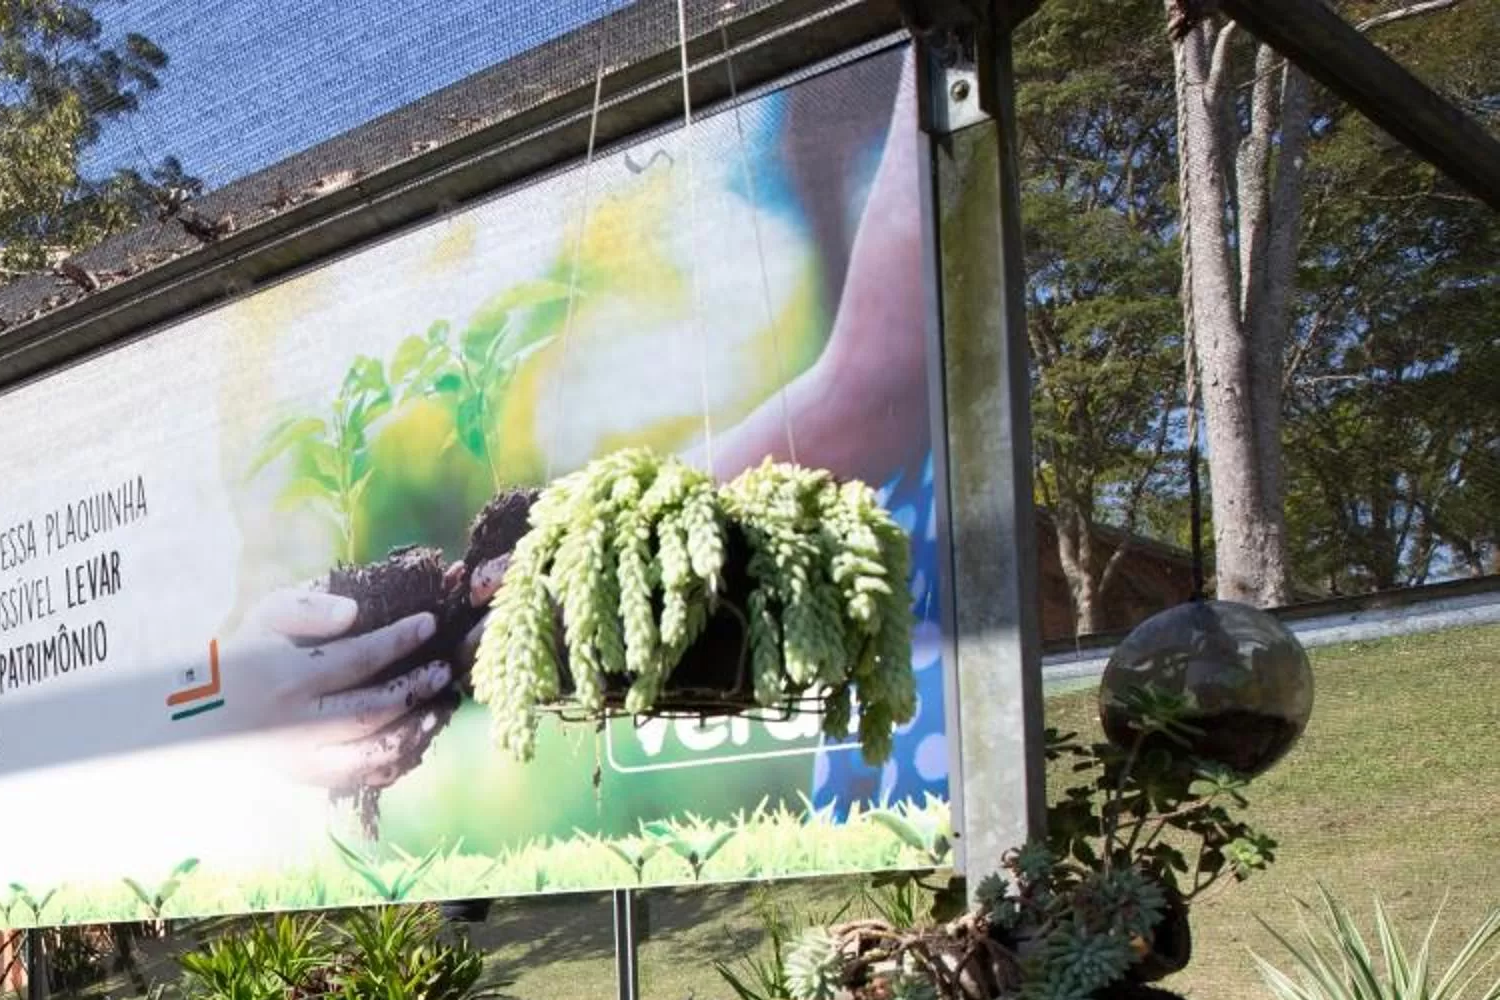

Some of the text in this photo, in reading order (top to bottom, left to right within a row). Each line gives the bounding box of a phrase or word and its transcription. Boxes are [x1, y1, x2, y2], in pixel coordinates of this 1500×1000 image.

[0, 520, 38, 572] ESSA
[45, 475, 148, 556] PLAQUINHA
[64, 550, 123, 610] LEVAR
